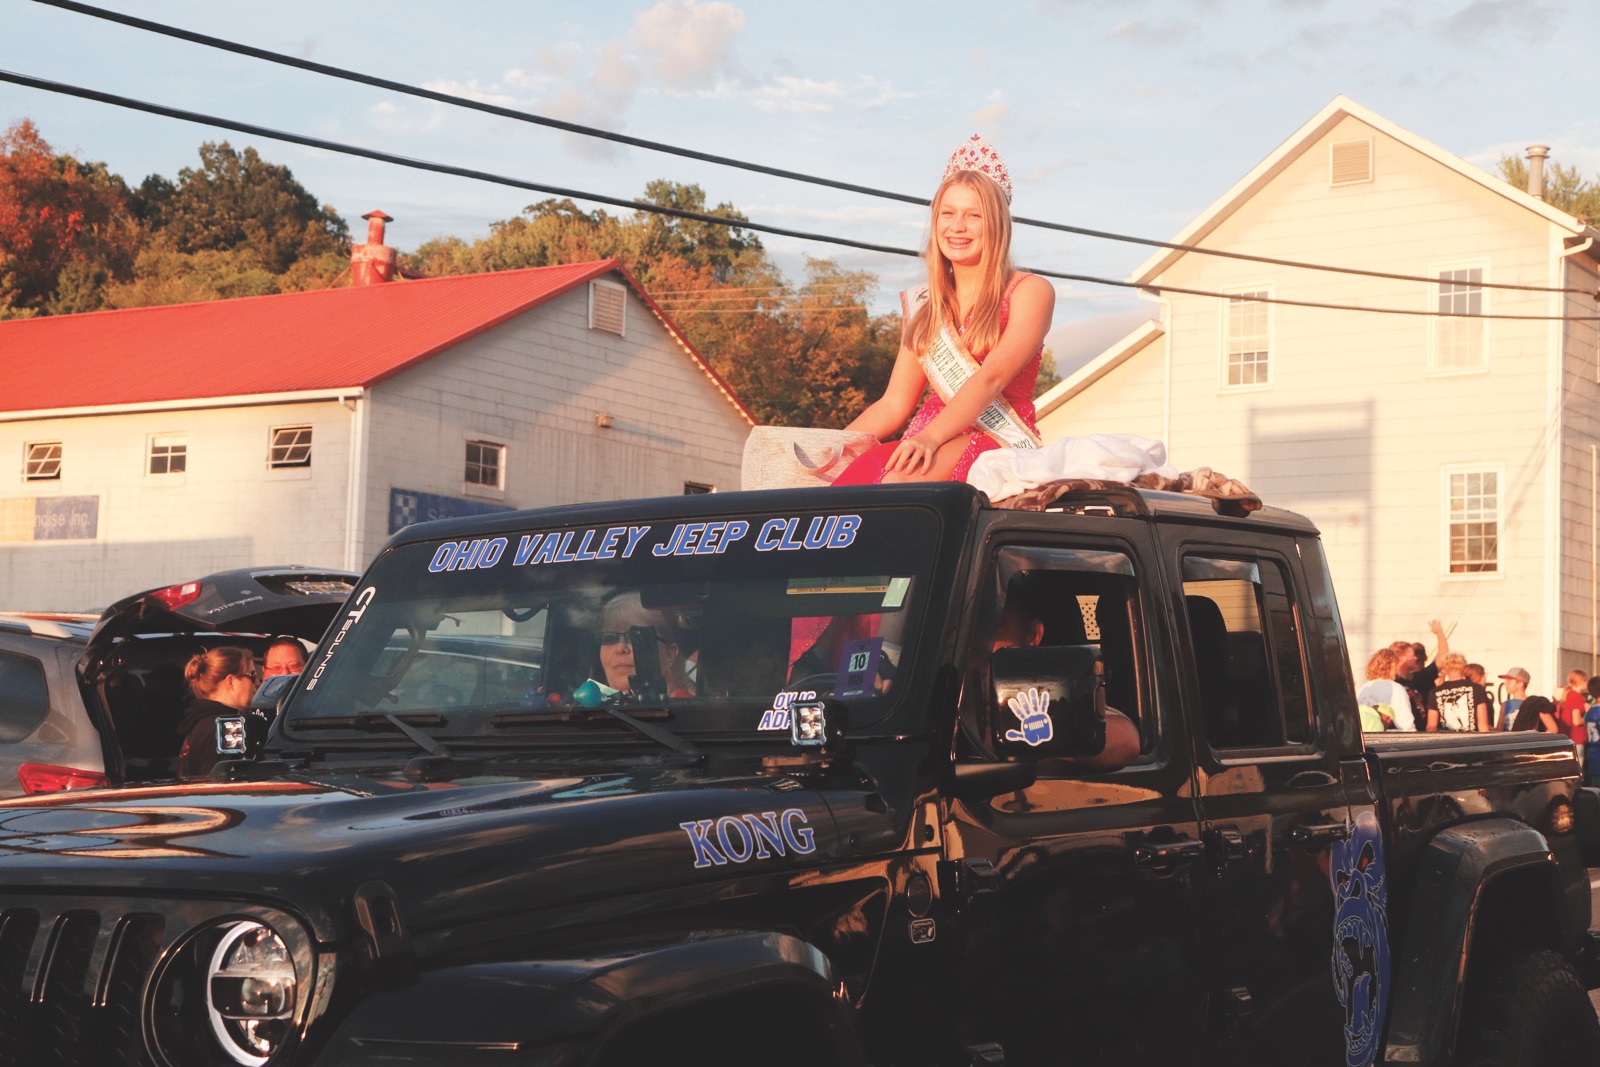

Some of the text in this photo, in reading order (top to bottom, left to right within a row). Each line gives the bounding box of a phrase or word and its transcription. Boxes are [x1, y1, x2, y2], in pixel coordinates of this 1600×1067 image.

[428, 514, 863, 573] OHIO VALLEY JEEP CLUB
[853, 653, 866, 670] 10
[680, 808, 816, 868] KONG
